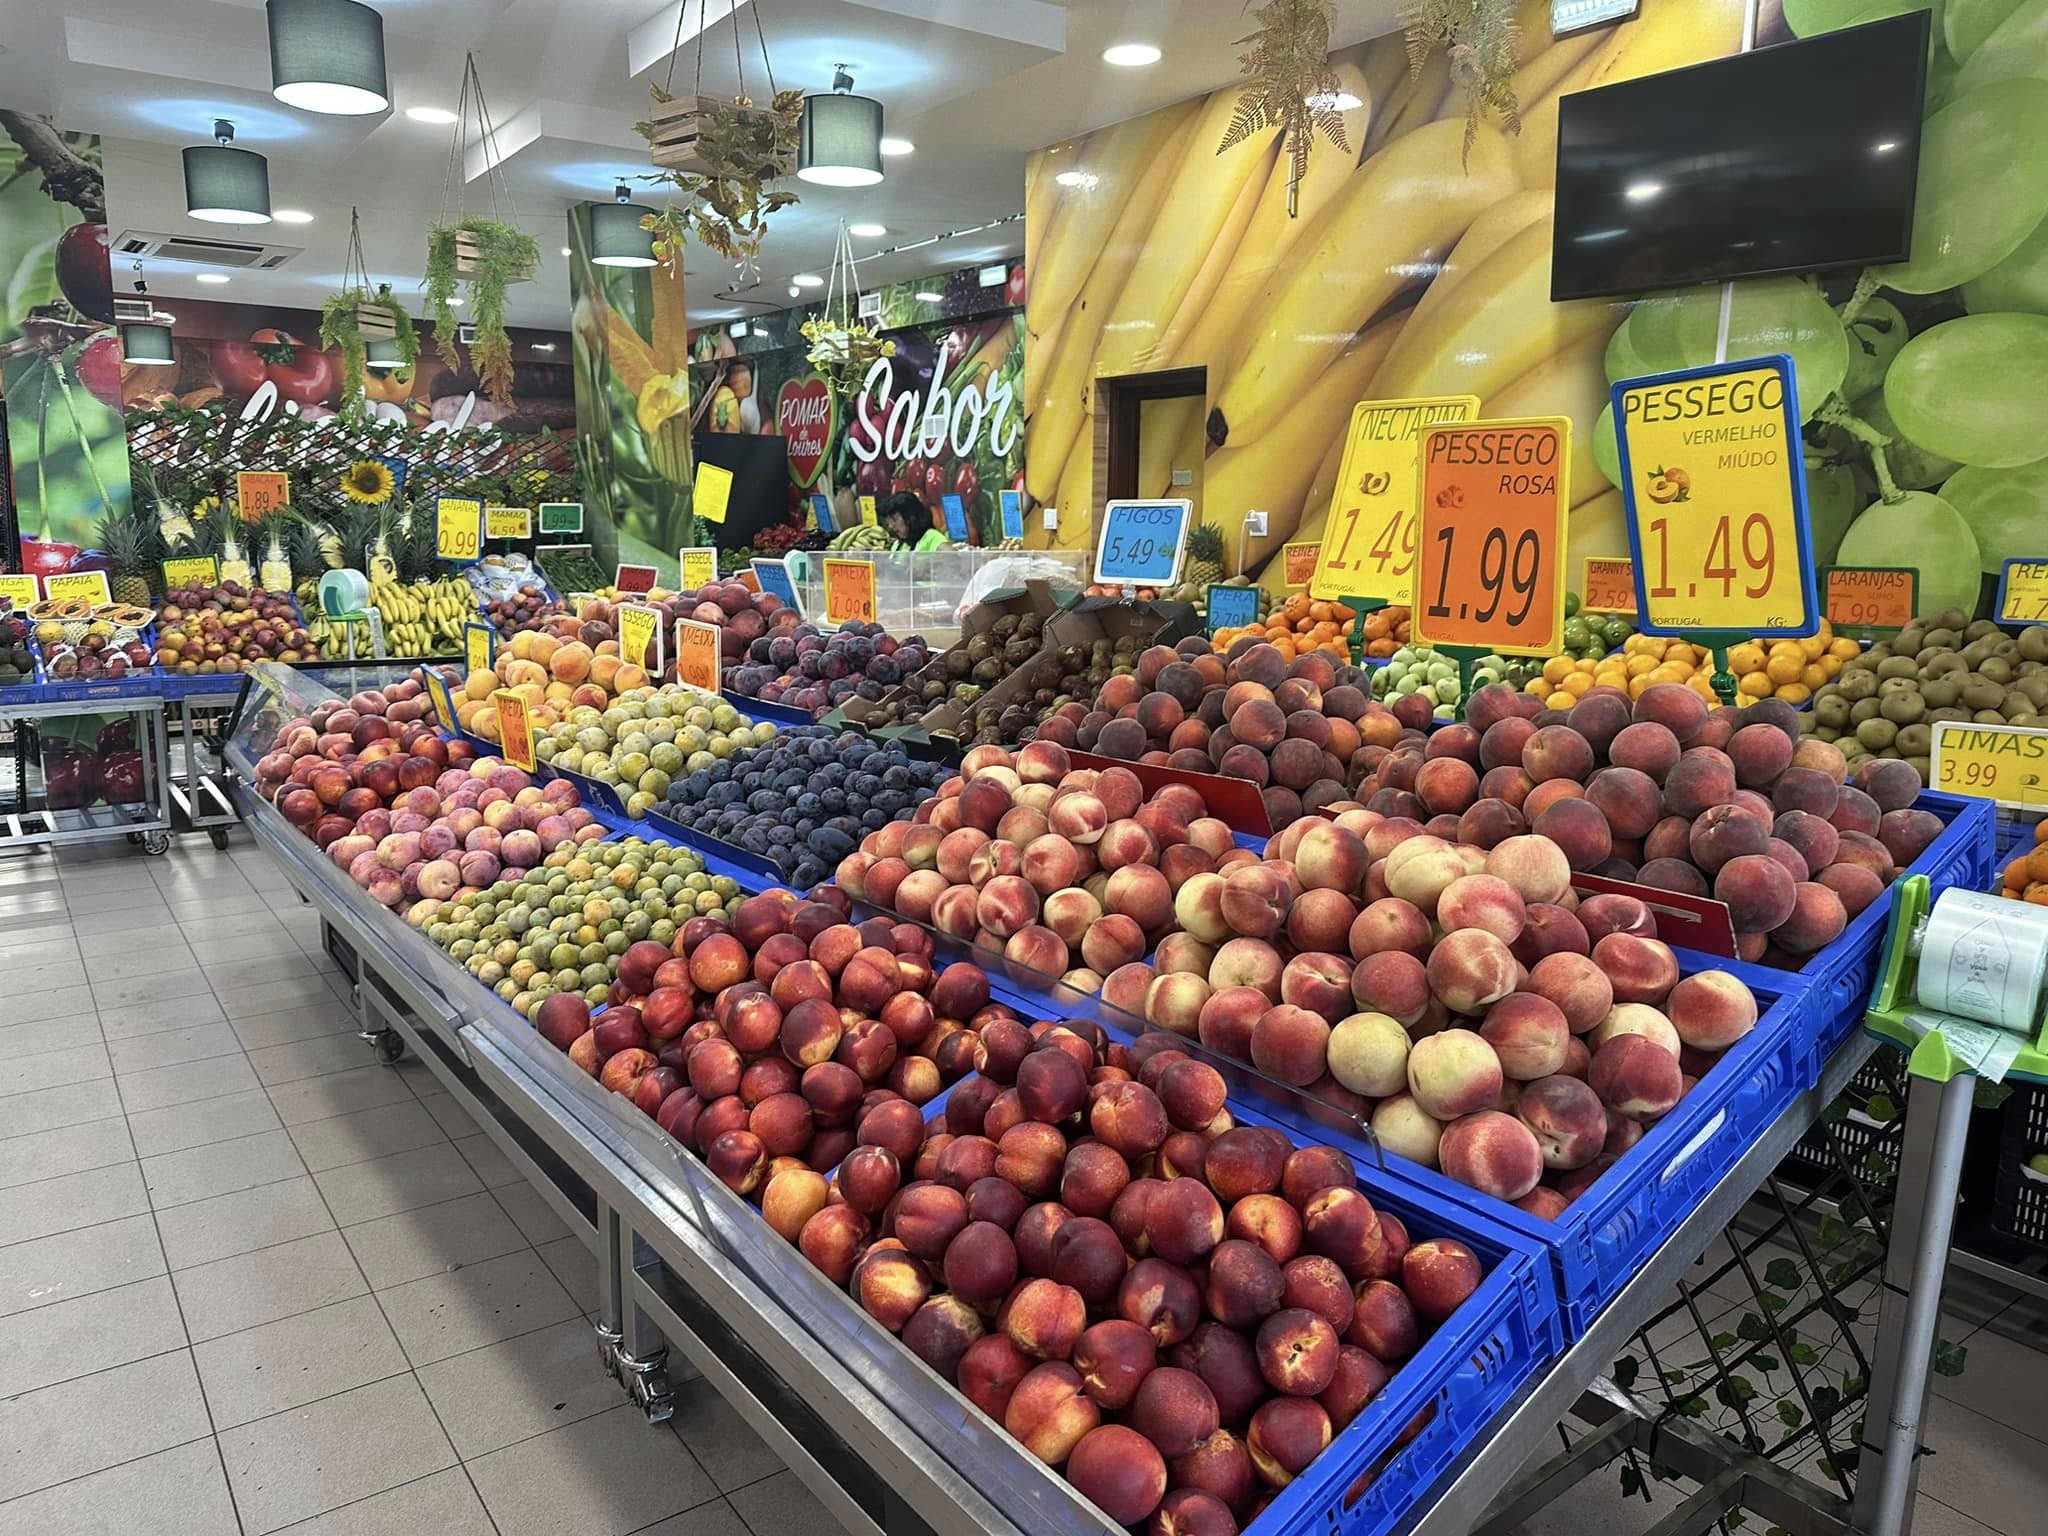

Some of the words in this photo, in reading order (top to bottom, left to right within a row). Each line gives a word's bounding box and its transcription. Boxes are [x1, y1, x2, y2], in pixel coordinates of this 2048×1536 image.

[780, 396, 830, 426] POMAR
[850, 341, 1017, 462] Sabor
[1625, 376, 1783, 424] PESSEGO
[787, 437, 822, 457] Loures
[1682, 423, 1777, 446] VERMELHO
[1431, 434, 1557, 465] PESSEGO
[1718, 450, 1777, 469] MIÚDO
[1499, 475, 1556, 495] ROSA
[1115, 508, 1176, 525] FIGOS
[438, 529, 477, 556] 0.99
[1107, 537, 1155, 565] 5.49
[1327, 508, 1416, 576] 1.49
[1650, 512, 1775, 599] 1.49
[50, 576, 93, 586] PAPAIA
[1319, 583, 1356, 593] PORTUGAL
[1428, 526, 1540, 627] 1.99
[1830, 571, 1904, 590] LARANJAS
[1213, 589, 1253, 602] PERA
[1651, 616, 1703, 626] PORTUGAL
[1767, 616, 1788, 628] KG:
[1940, 728, 2048, 758] LIMAS
[1939, 760, 1997, 787] 3.99
